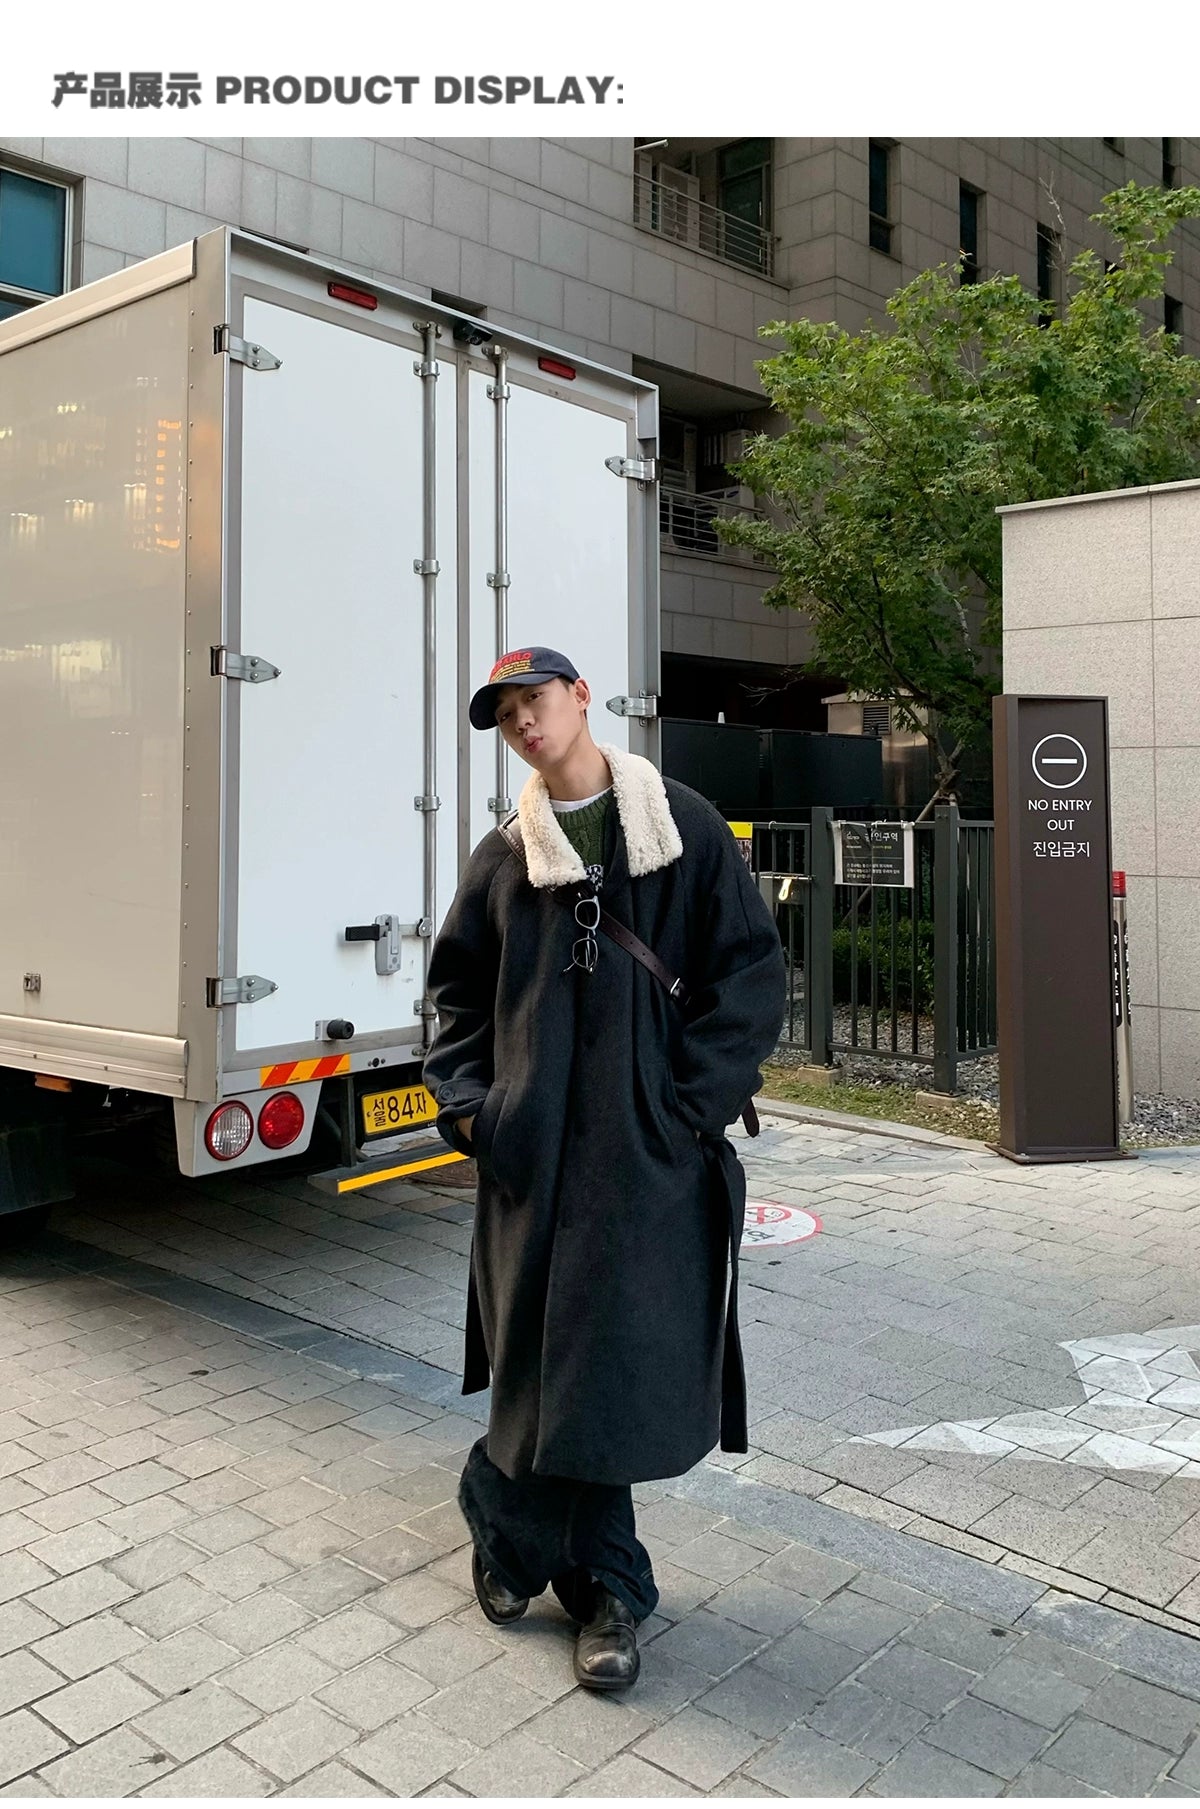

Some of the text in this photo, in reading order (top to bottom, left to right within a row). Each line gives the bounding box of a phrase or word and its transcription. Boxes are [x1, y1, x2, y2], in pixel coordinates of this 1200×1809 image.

[1028, 799, 1093, 811] NO ENTRY
[1047, 819, 1075, 831] OUT
[1033, 841, 1090, 858] 진입금지
